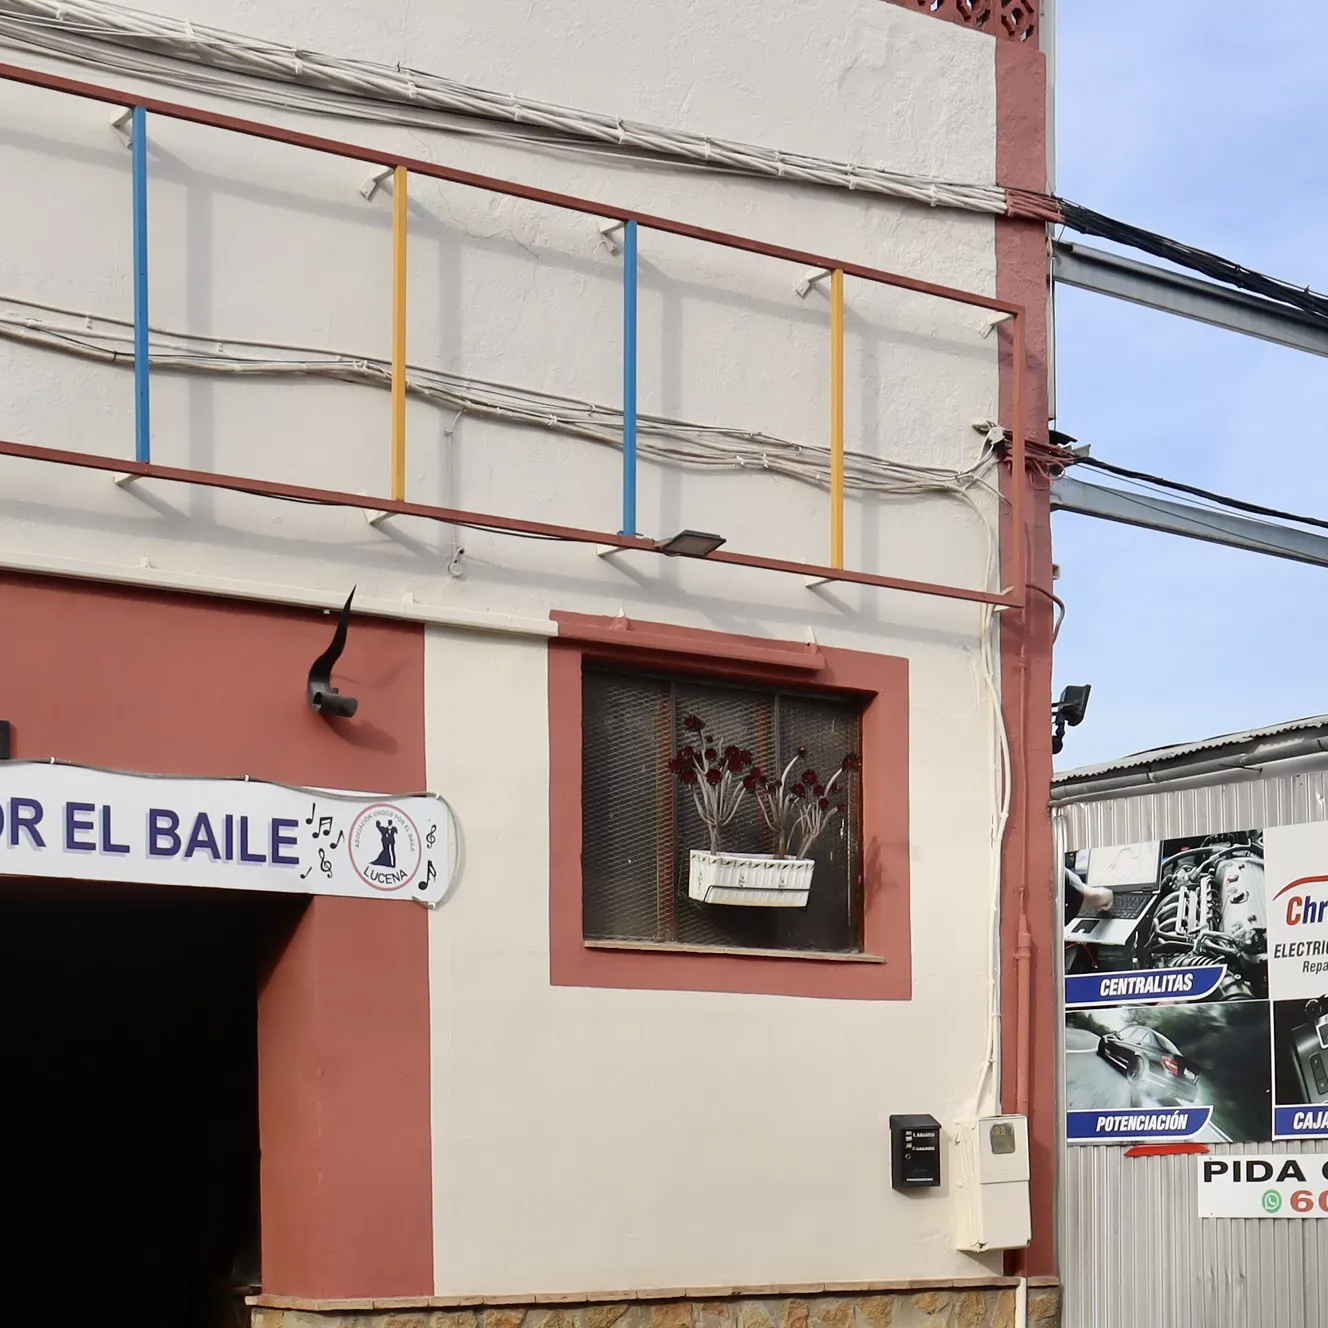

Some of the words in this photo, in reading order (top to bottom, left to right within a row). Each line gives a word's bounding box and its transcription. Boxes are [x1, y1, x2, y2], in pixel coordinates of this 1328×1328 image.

[66, 801, 131, 855] EL
[149, 808, 301, 867] BAILE
[363, 866, 408, 884] LUCENA
[1099, 973, 1194, 997] CENTRALITAS
[1096, 1110, 1189, 1132] POTENCIACIÓN
[1203, 1160, 1307, 1183] PIDA
